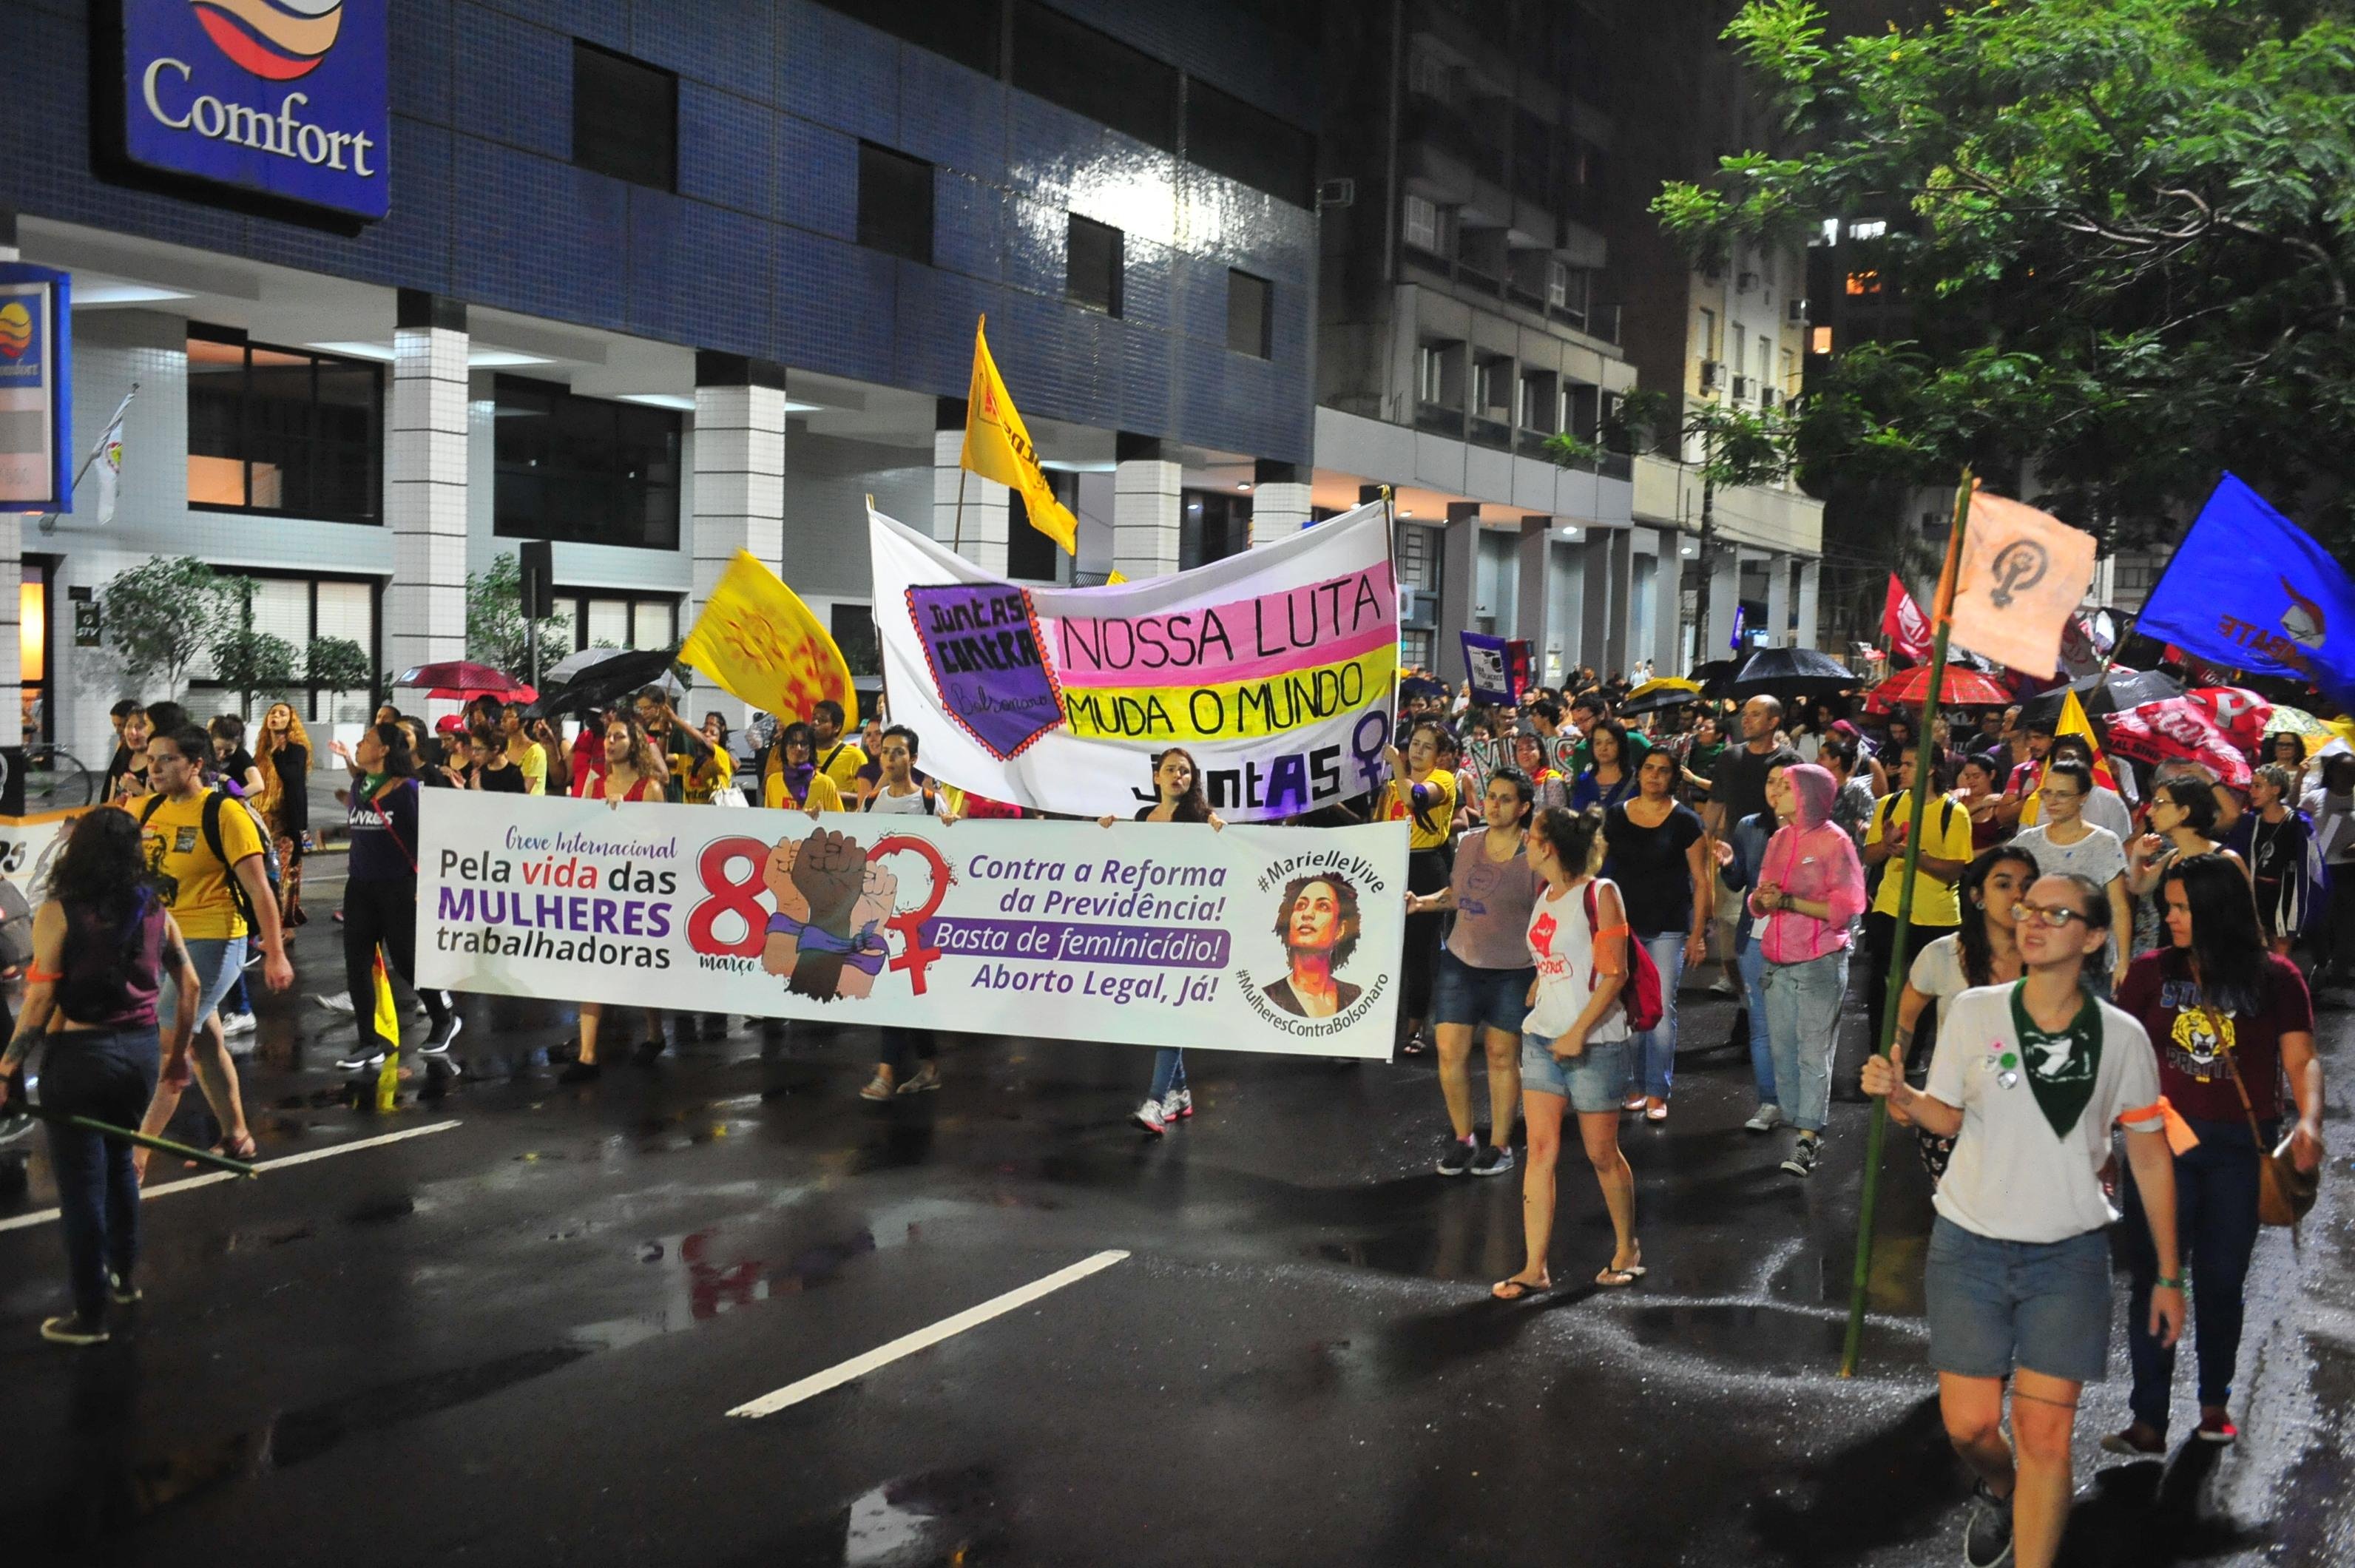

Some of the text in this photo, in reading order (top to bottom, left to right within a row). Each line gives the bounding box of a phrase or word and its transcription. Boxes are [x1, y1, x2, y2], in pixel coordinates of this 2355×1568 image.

[142, 57, 375, 178] Comfort
[1061, 574, 1382, 671] NOSSA LUTA
[1066, 661, 1364, 737] MUDA O MUNDO
[505, 825, 678, 859] Greve Internacional
[440, 848, 677, 895] Pela vida das
[967, 855, 1226, 891] Contra a Reforma
[1258, 850, 1385, 893] #MarielleVive
[438, 886, 673, 938] MULHERES
[1000, 888, 1226, 922] da Previdência!
[436, 926, 669, 970] trabalhadoras
[933, 922, 1222, 963] Basta de feminicídio!
[699, 955, 755, 976] março
[971, 964, 1220, 1007] Aborto Legal, Já!
[1236, 969, 1388, 1037] #MulheresContraBolsonaro
